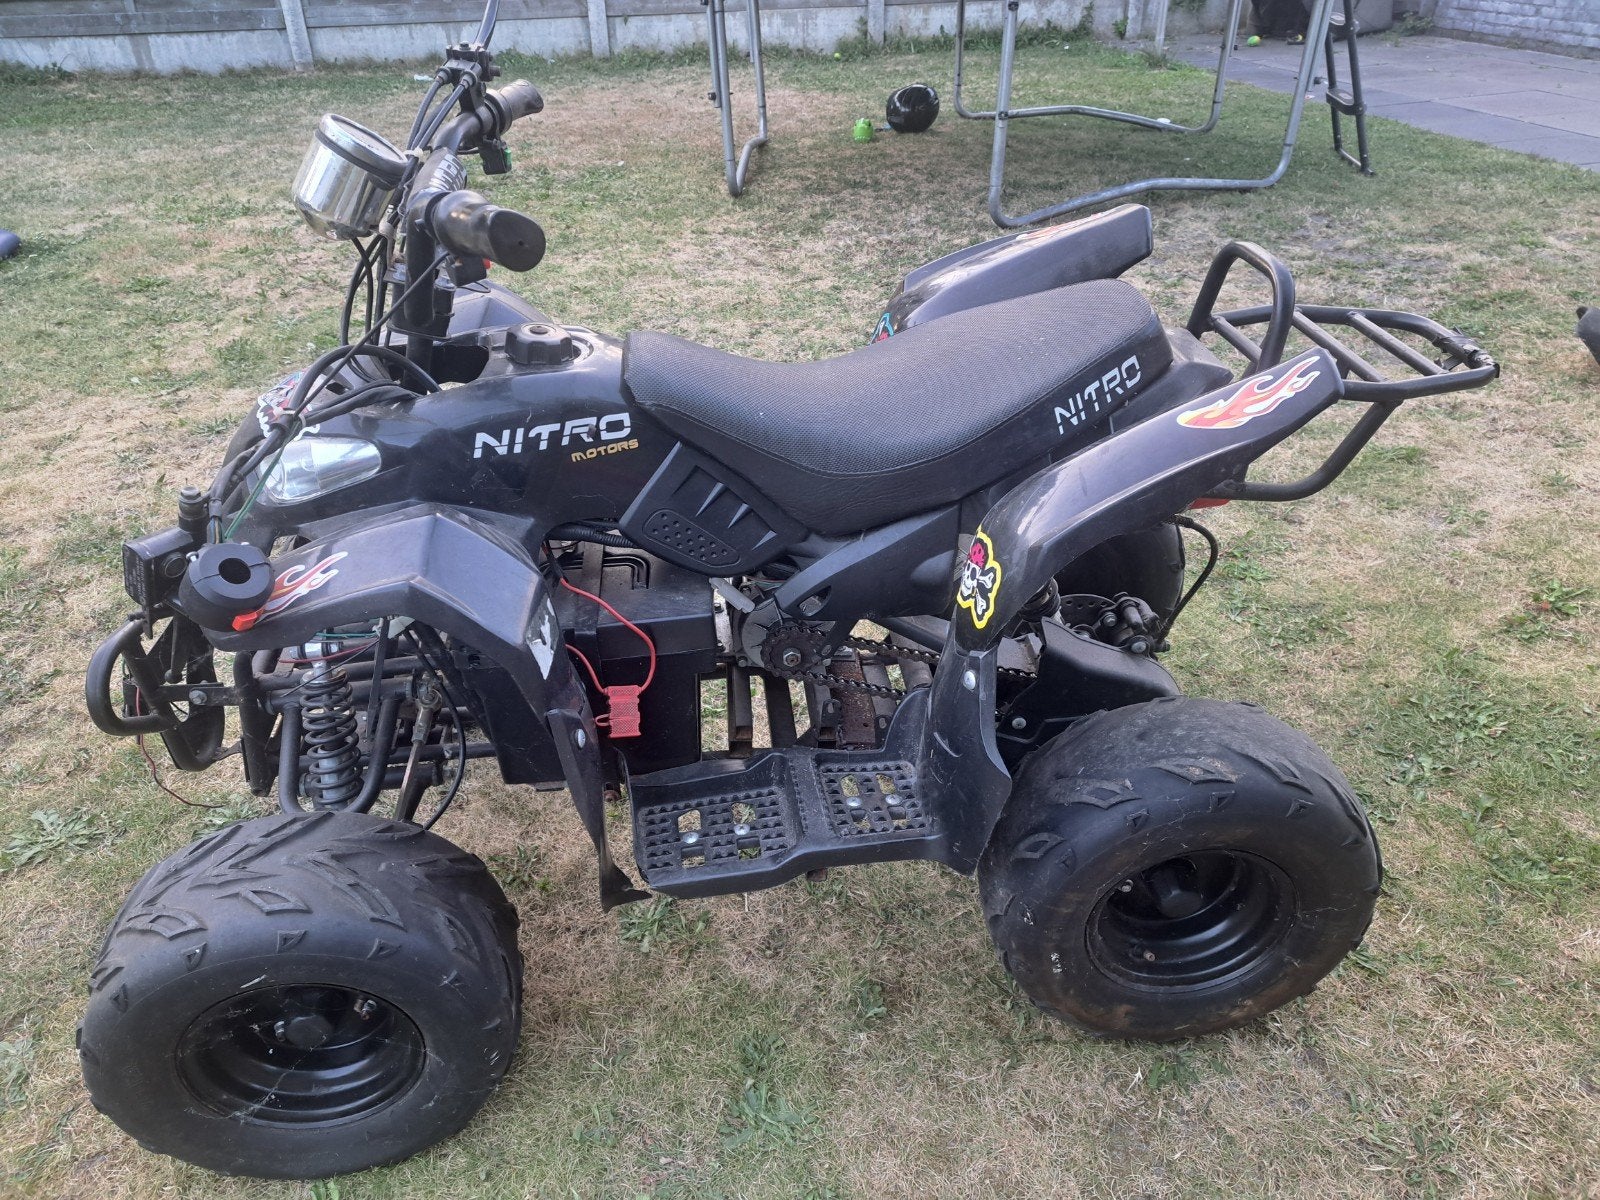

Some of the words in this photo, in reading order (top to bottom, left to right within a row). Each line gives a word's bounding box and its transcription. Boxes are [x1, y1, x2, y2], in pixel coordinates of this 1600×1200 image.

[1054, 354, 1141, 435] NITRO
[473, 412, 631, 458] NITRO
[570, 438, 639, 462] MOTORS
